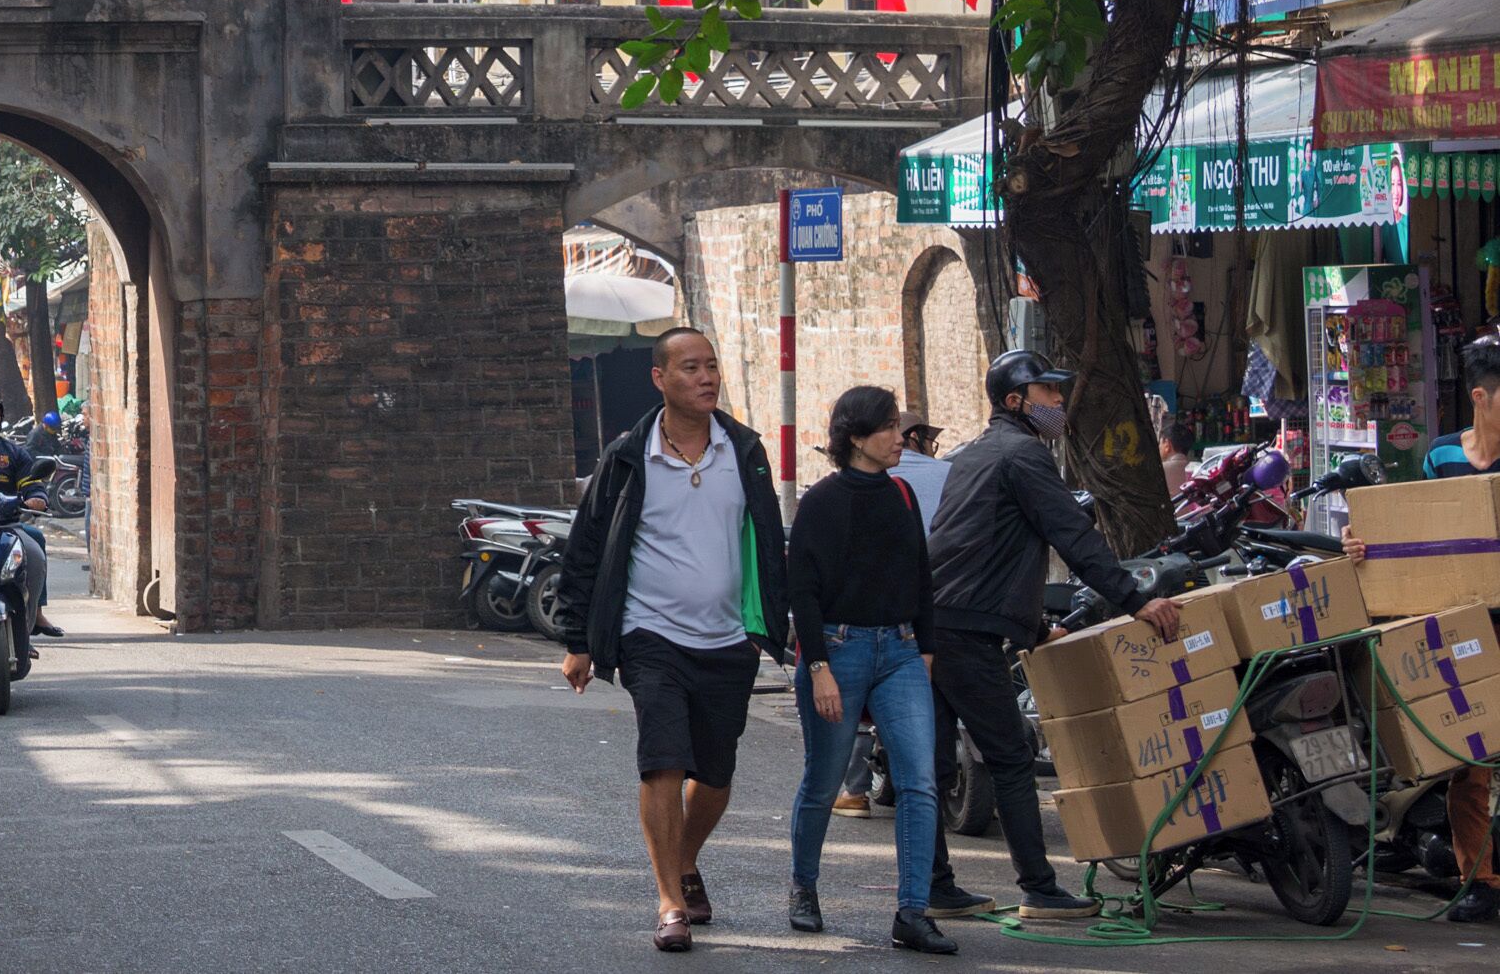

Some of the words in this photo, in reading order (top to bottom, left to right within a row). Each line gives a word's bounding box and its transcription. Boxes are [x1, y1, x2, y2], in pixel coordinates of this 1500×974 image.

[1466, 98, 1497, 127] BÁN
[905, 162, 920, 191] HÀ
[922, 161, 945, 191] LIÊN
[1248, 155, 1280, 187] THU
[806, 199, 824, 217] PHỐ
[797, 224, 813, 252] QUAN
[1131, 665, 1151, 678] 70
